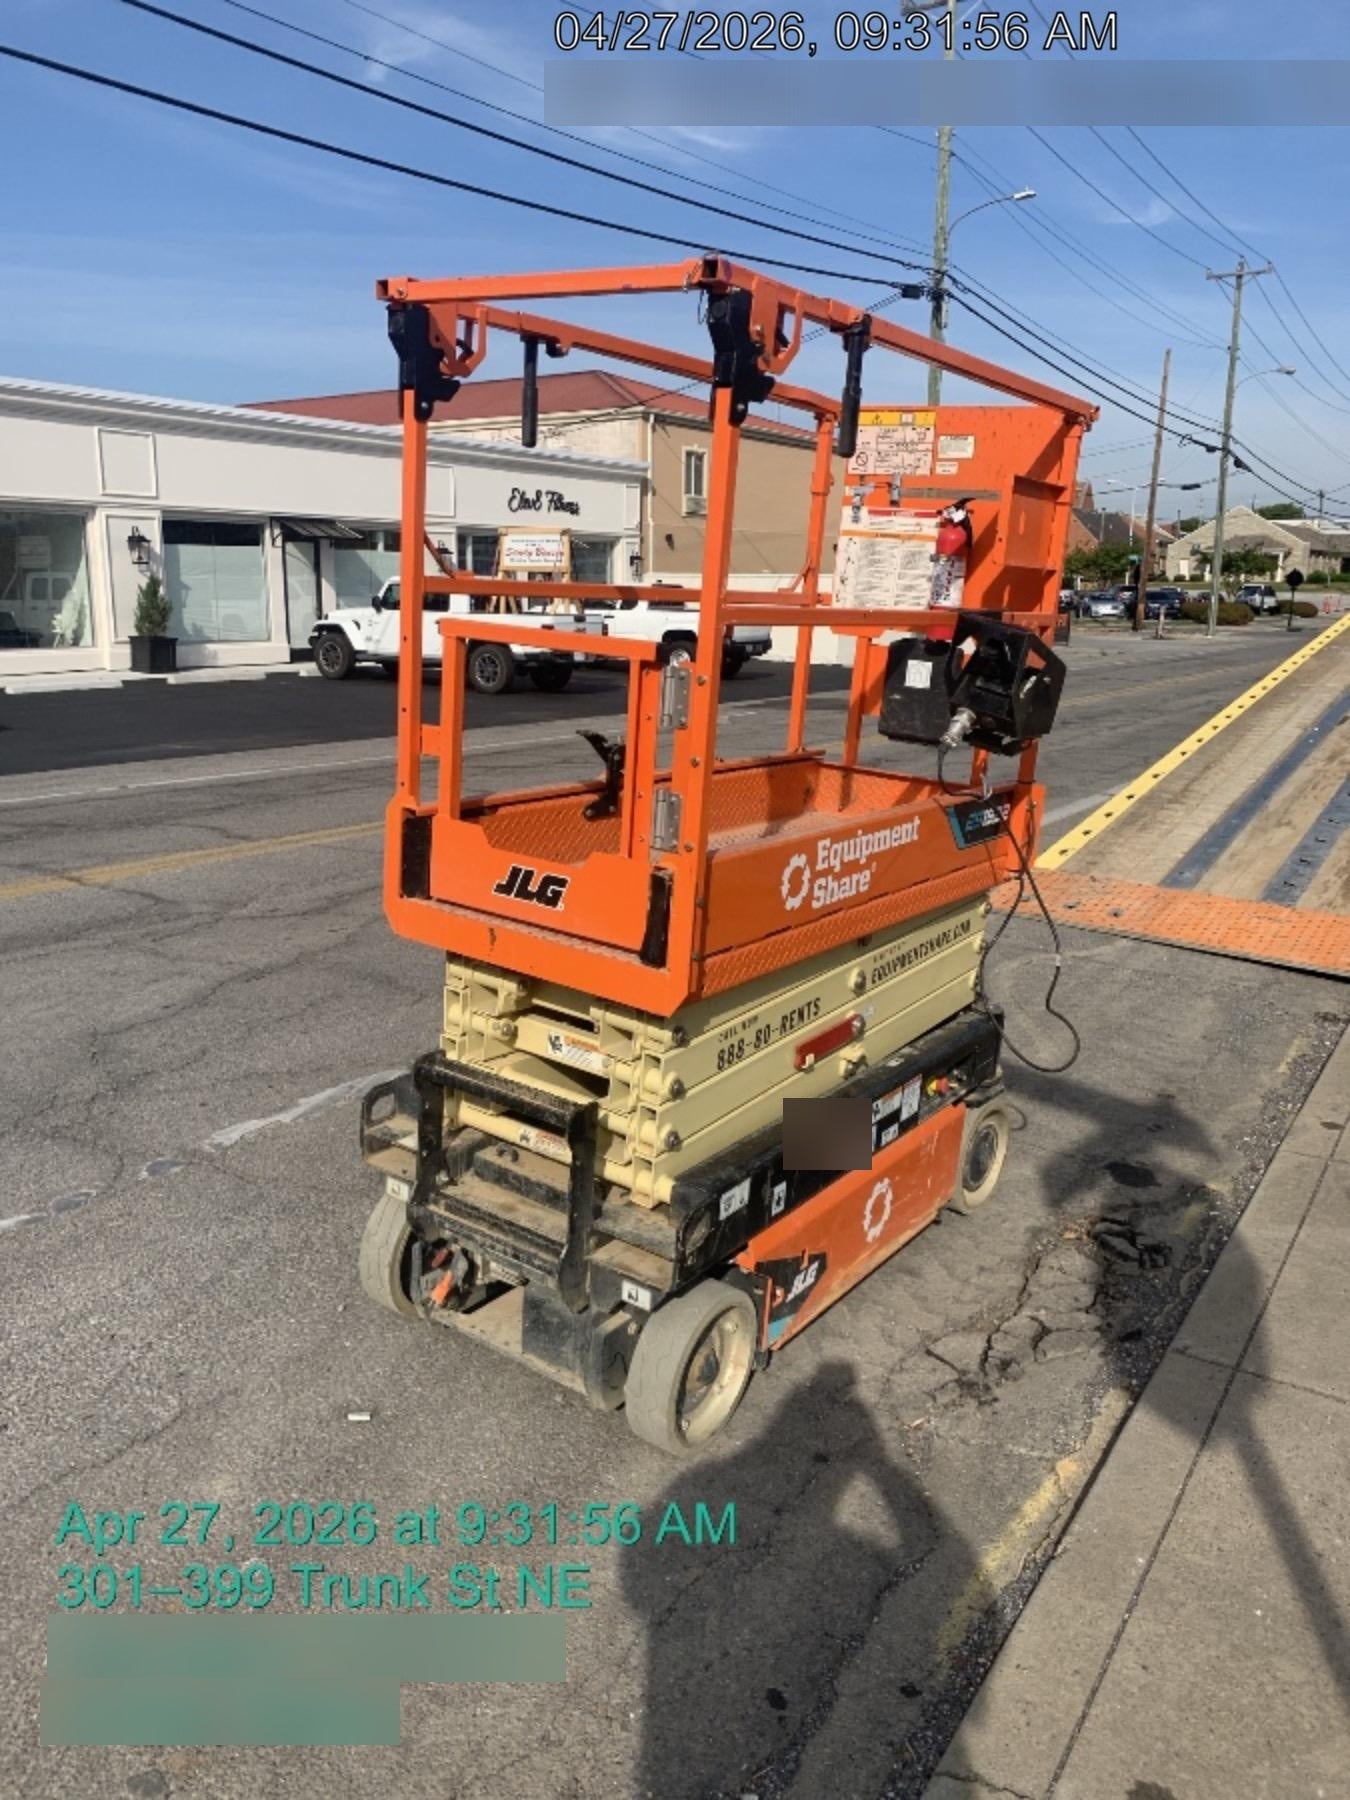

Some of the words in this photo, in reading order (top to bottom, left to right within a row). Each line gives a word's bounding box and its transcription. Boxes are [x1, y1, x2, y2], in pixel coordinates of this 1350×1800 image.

[816, 816, 921, 872] Equipment
[492, 864, 570, 911] JLG
[811, 867, 871, 909] Share
[786, 1260, 820, 1303] JLG
